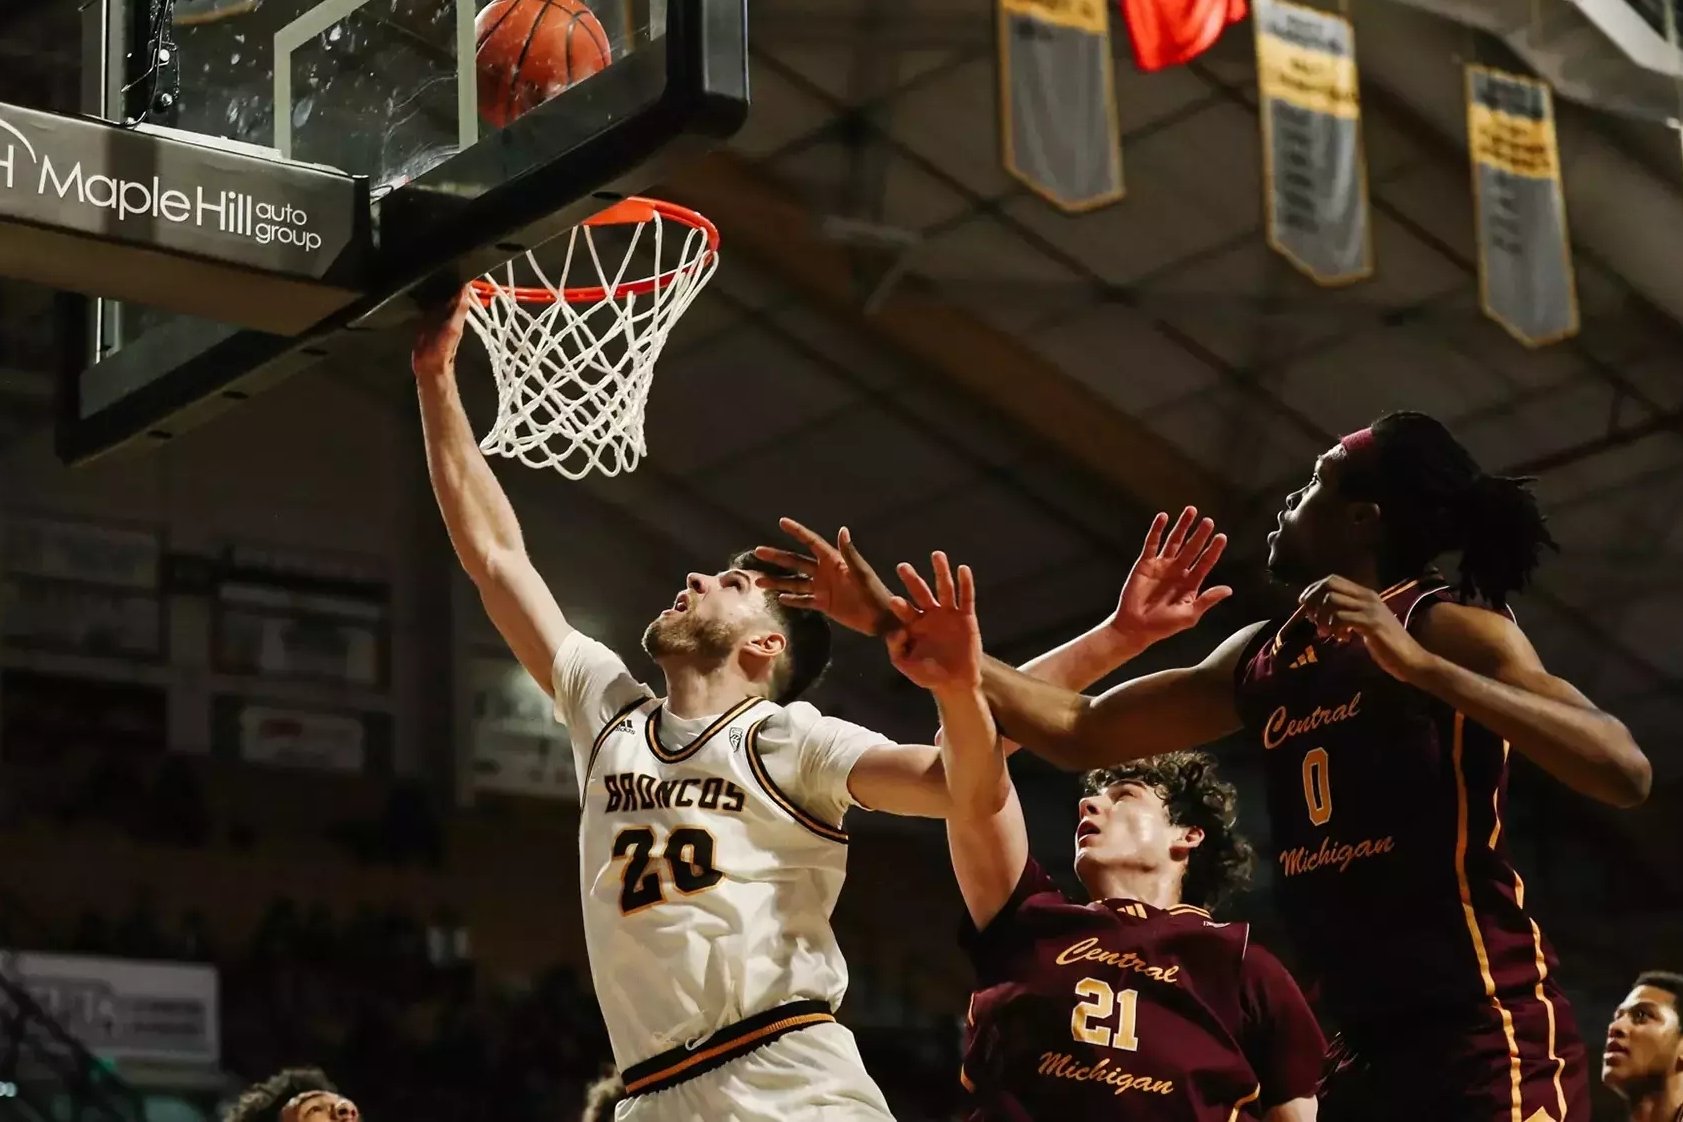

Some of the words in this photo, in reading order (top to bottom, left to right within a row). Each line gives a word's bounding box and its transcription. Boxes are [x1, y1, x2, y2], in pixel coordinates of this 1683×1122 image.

[255, 203, 308, 226] auto
[255, 223, 322, 252] group
[1262, 690, 1363, 750] Central
[604, 772, 746, 813] BRONCOS
[1302, 746, 1333, 827] 0
[612, 825, 724, 916] 20
[1278, 835, 1396, 878] Michigan
[1055, 936, 1180, 984] Central
[1070, 976, 1139, 1052] 21
[1037, 1051, 1175, 1095] Michigan
